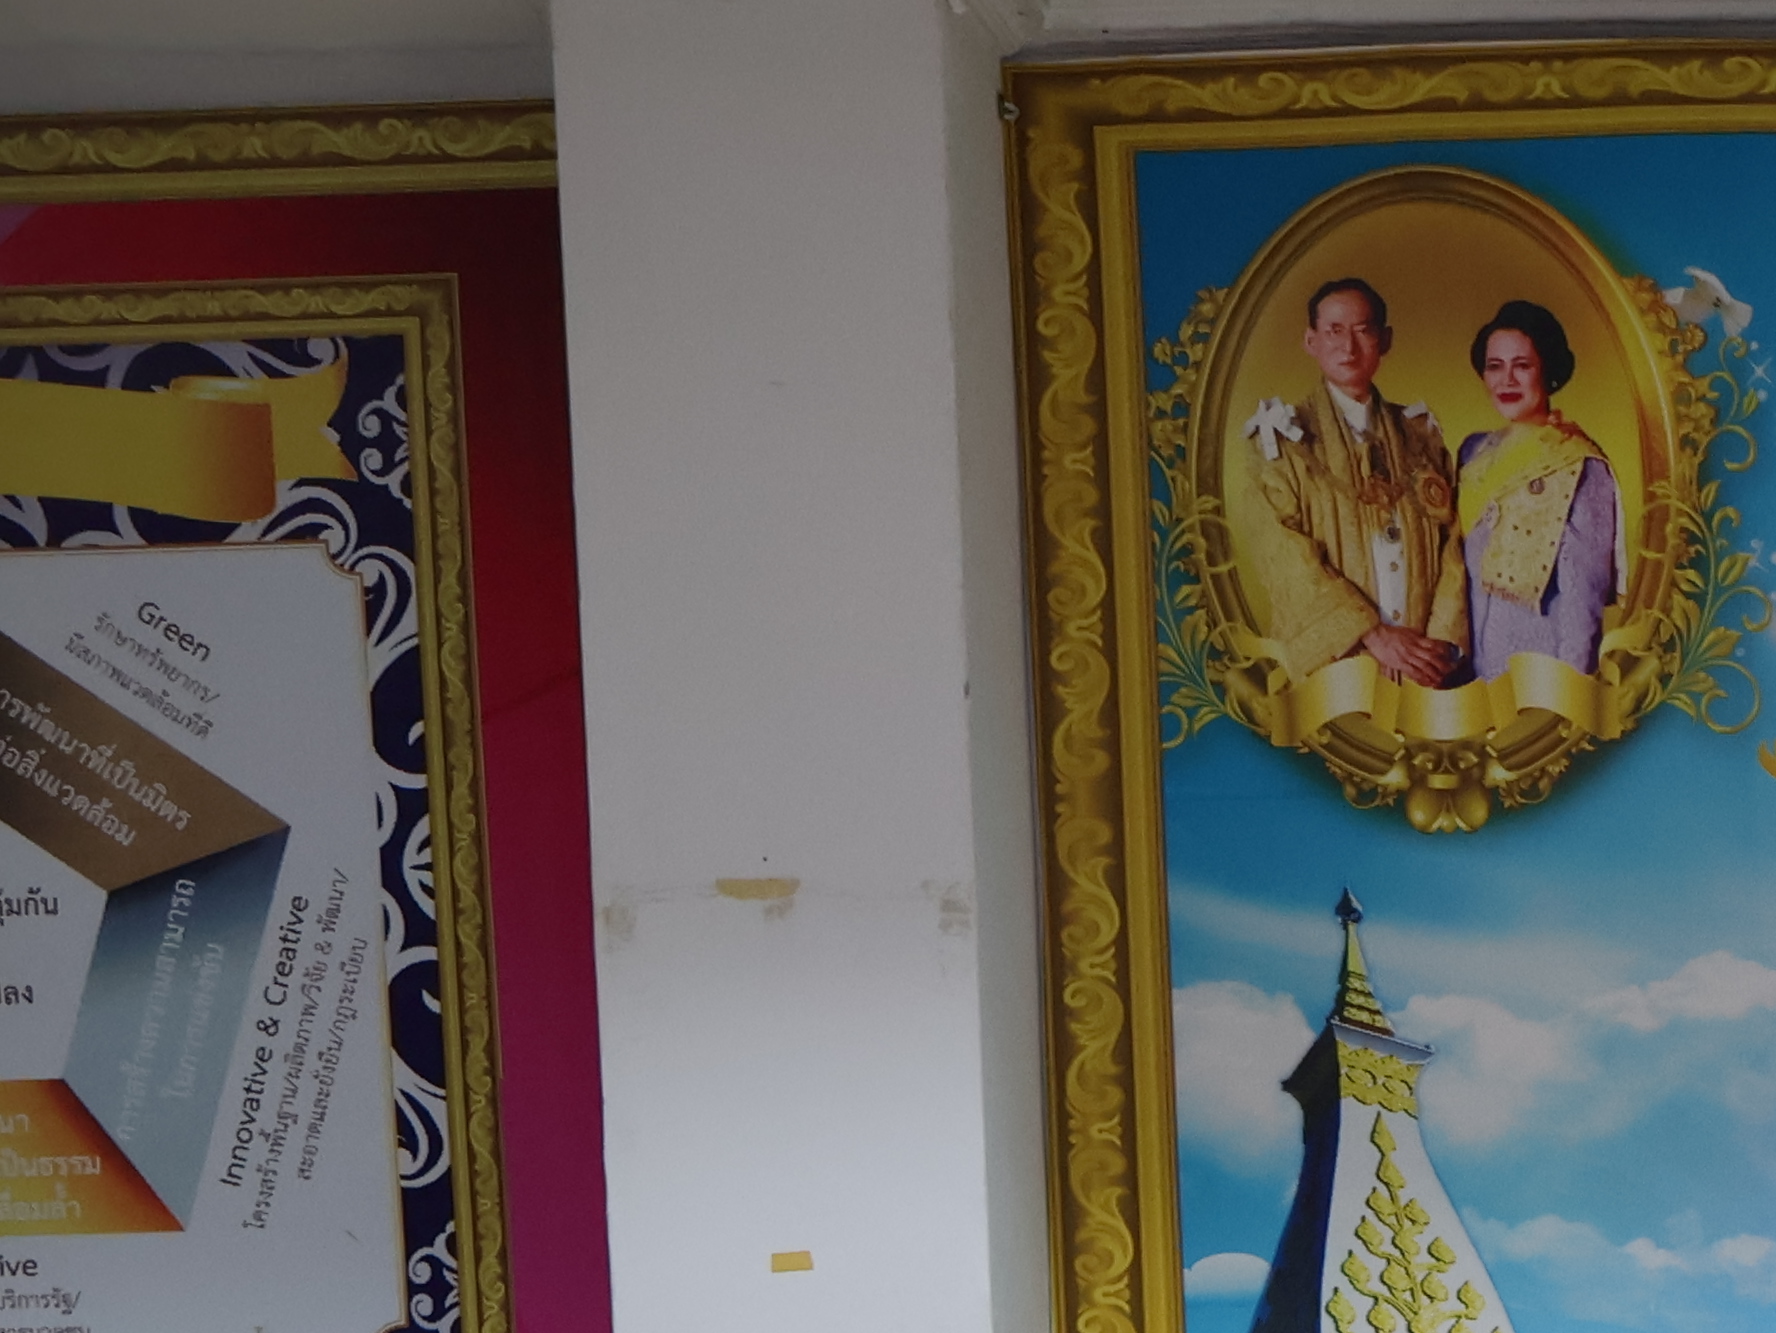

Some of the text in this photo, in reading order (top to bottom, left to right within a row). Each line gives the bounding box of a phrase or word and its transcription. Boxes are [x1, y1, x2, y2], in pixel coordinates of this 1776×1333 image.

[138, 601, 212, 663] Green
[219, 894, 310, 1188] Innovative & Creative
